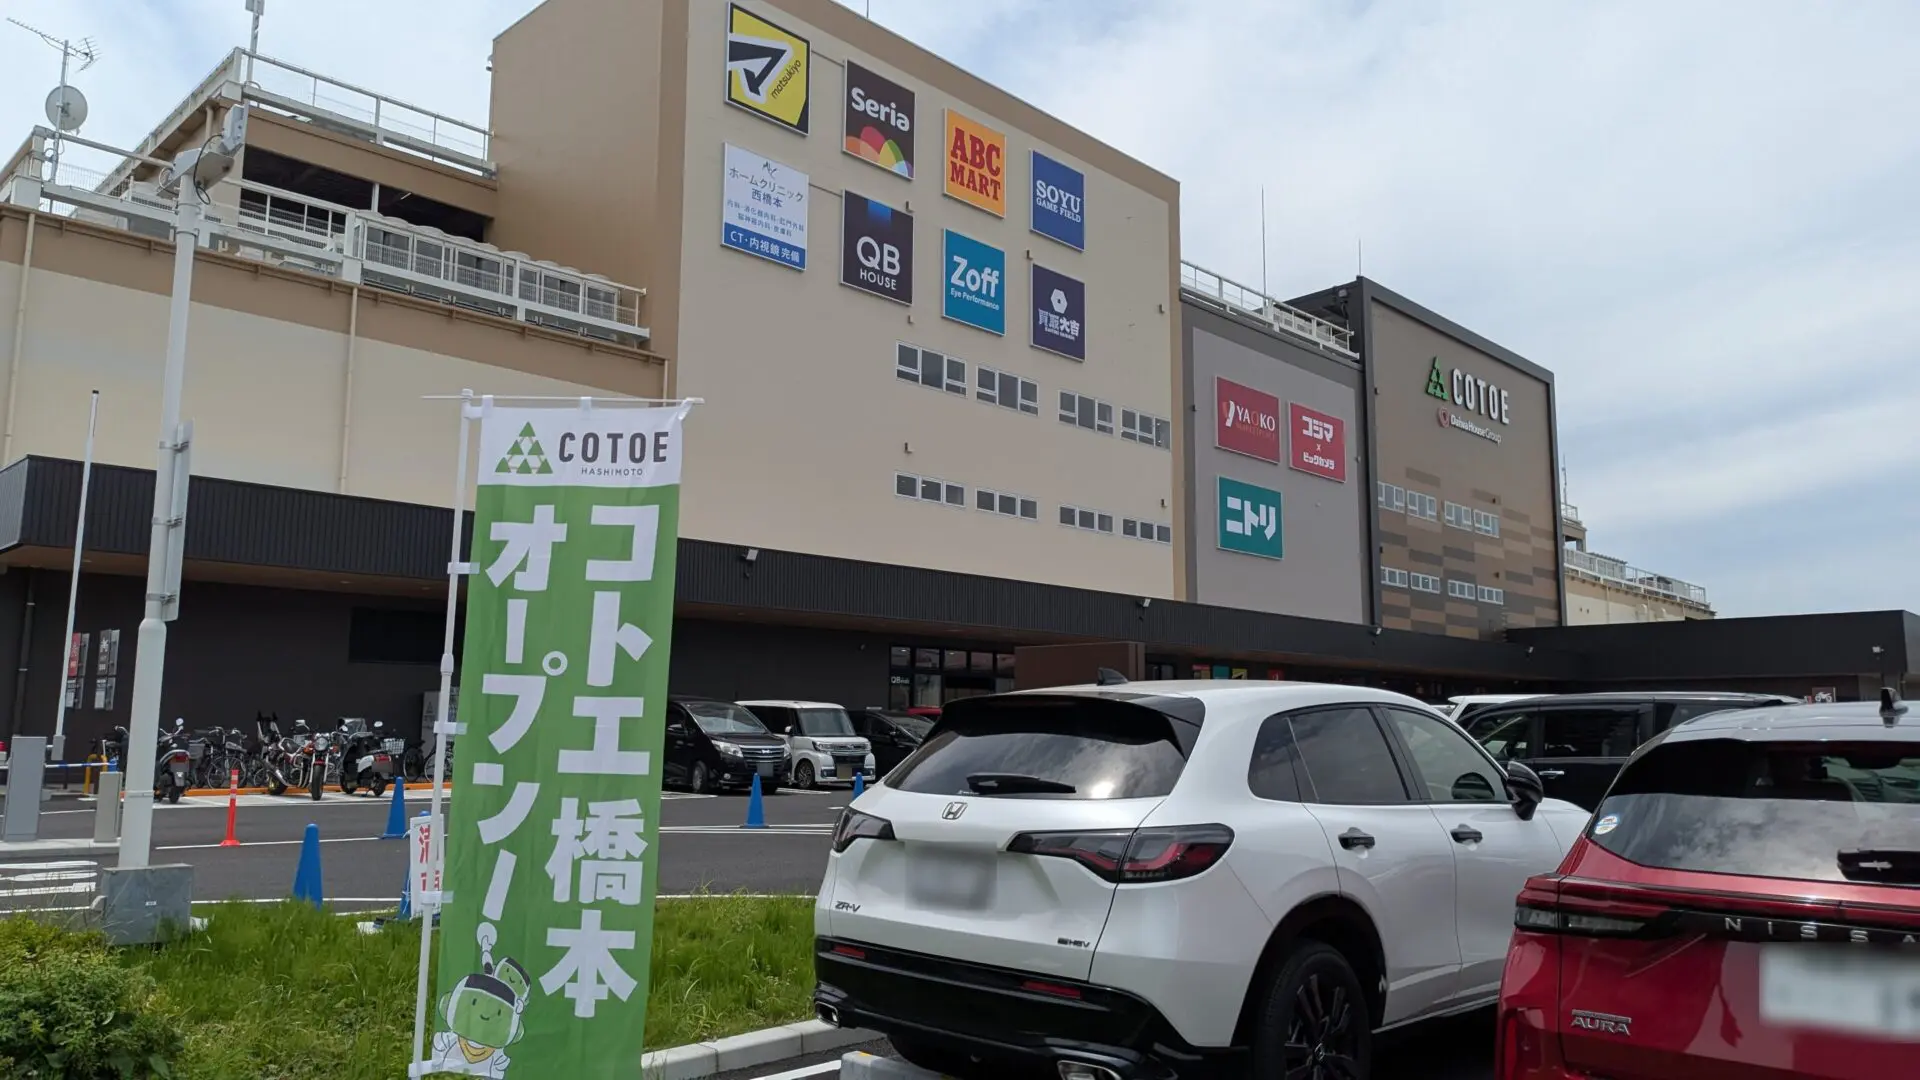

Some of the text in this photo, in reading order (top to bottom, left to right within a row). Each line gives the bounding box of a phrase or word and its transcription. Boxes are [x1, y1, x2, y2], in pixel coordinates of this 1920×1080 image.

[771, 59, 802, 100] matsukiyo
[851, 86, 910, 132] Seria
[950, 127, 1000, 177] ABC
[729, 167, 803, 202] ホームクリニック
[950, 160, 1000, 201] MART
[1036, 180, 1081, 213] SOYU
[751, 188, 782, 208] 西橋本
[1036, 197, 1081, 223] GAME FIELD
[856, 236, 901, 276] QB
[859, 268, 897, 291] HOUSE
[951, 255, 1000, 298] Zoff
[950, 287, 1000, 311] Eye Performance
[1452, 368, 1510, 425] COTOE
[1236, 405, 1276, 432] YAOKO
[1302, 415, 1334, 443] コジマ
[558, 431, 670, 464] COTOE
[581, 467, 643, 477] HASHIMOTO
[1226, 496, 1276, 541] ニトリ
[539, 504, 660, 1018] コトエ橋本
[835, 900, 861, 913] ZR-V
[1571, 1016, 1632, 1036] AURA
